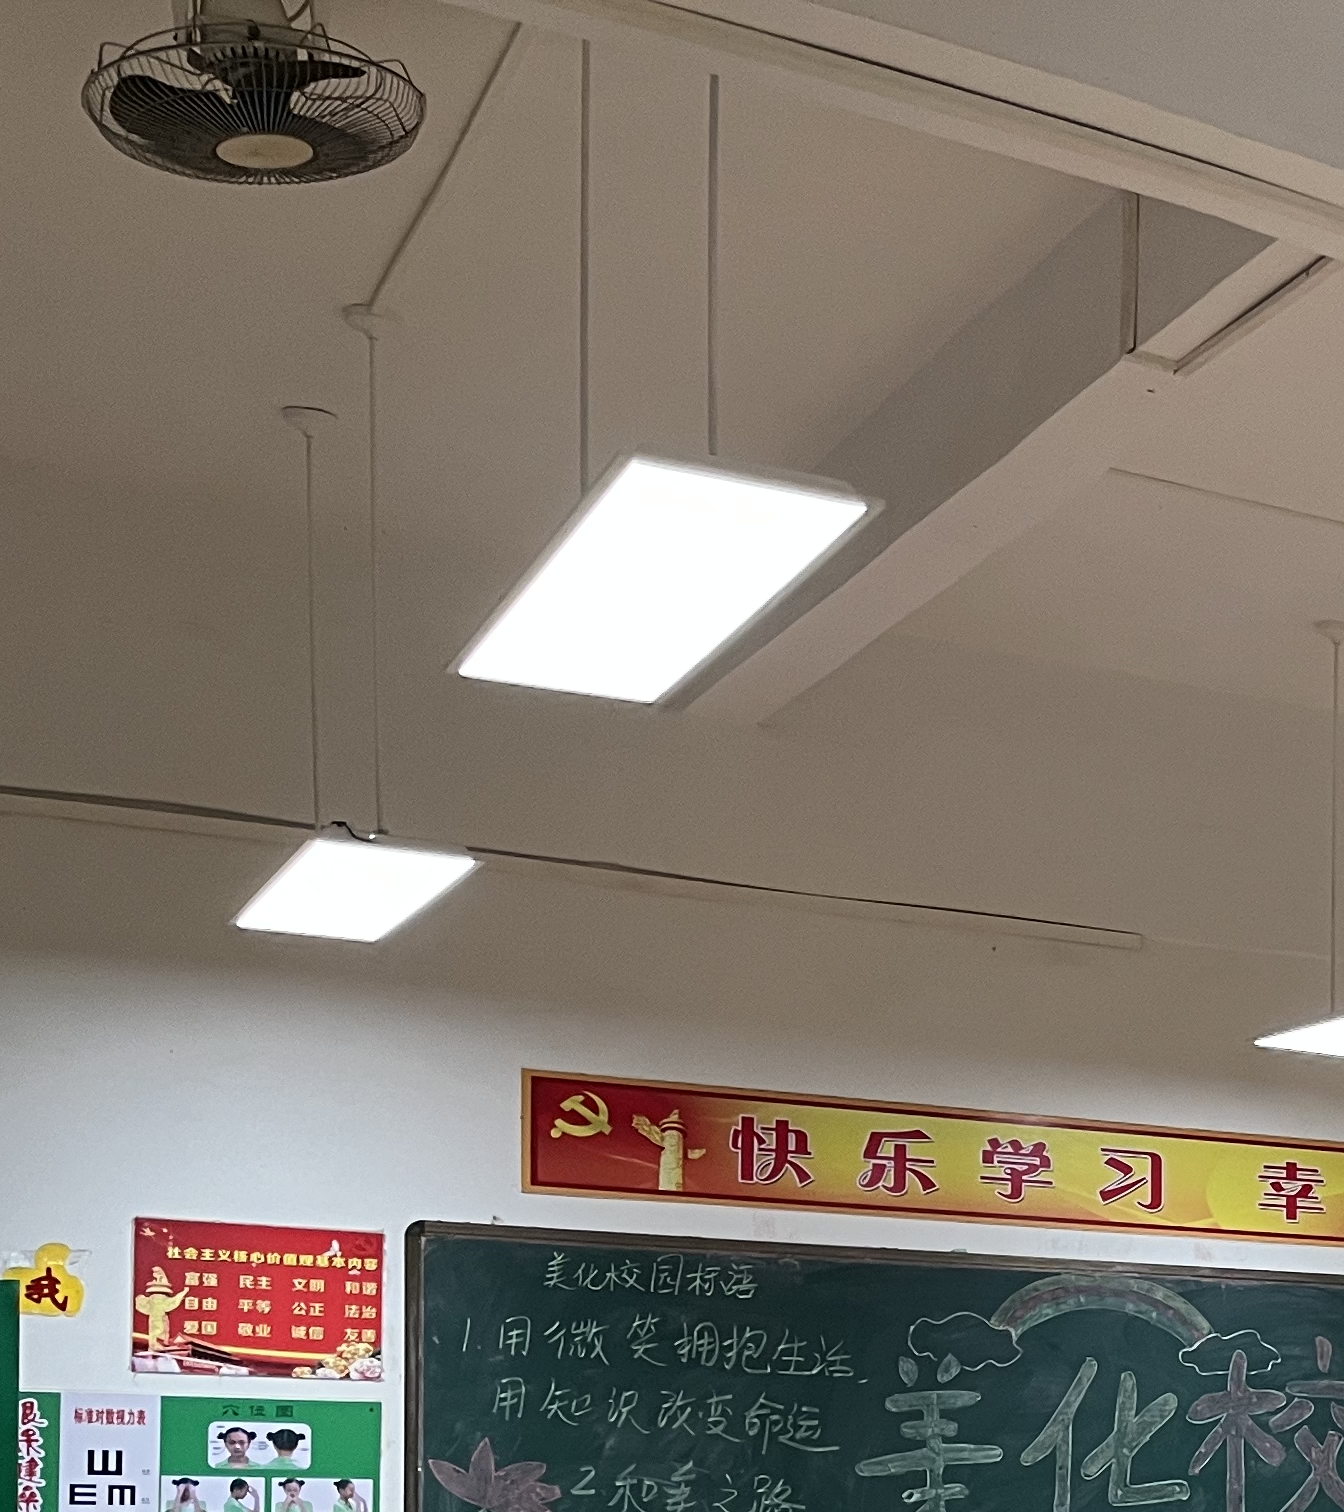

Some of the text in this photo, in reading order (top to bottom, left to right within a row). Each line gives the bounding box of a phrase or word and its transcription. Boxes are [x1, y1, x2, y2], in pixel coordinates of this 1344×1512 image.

[730, 1114, 1165, 1214] 快乐学习
[167, 1246, 379, 1271] 社会主义核心价值观基本内容
[184, 1272, 378, 1296] 富强 民主 文明 和谐
[543, 1252, 759, 1299] 美化校园标语
[184, 1297, 377, 1319] 自由 平等 公正 法治
[183, 1320, 377, 1343] 爱国 敬业 诚信 友善
[74, 1407, 146, 1427] 标准对数视力表
[222, 1404, 293, 1418] 穴位图
[492, 1375, 840, 1455] 用知识改变命运
